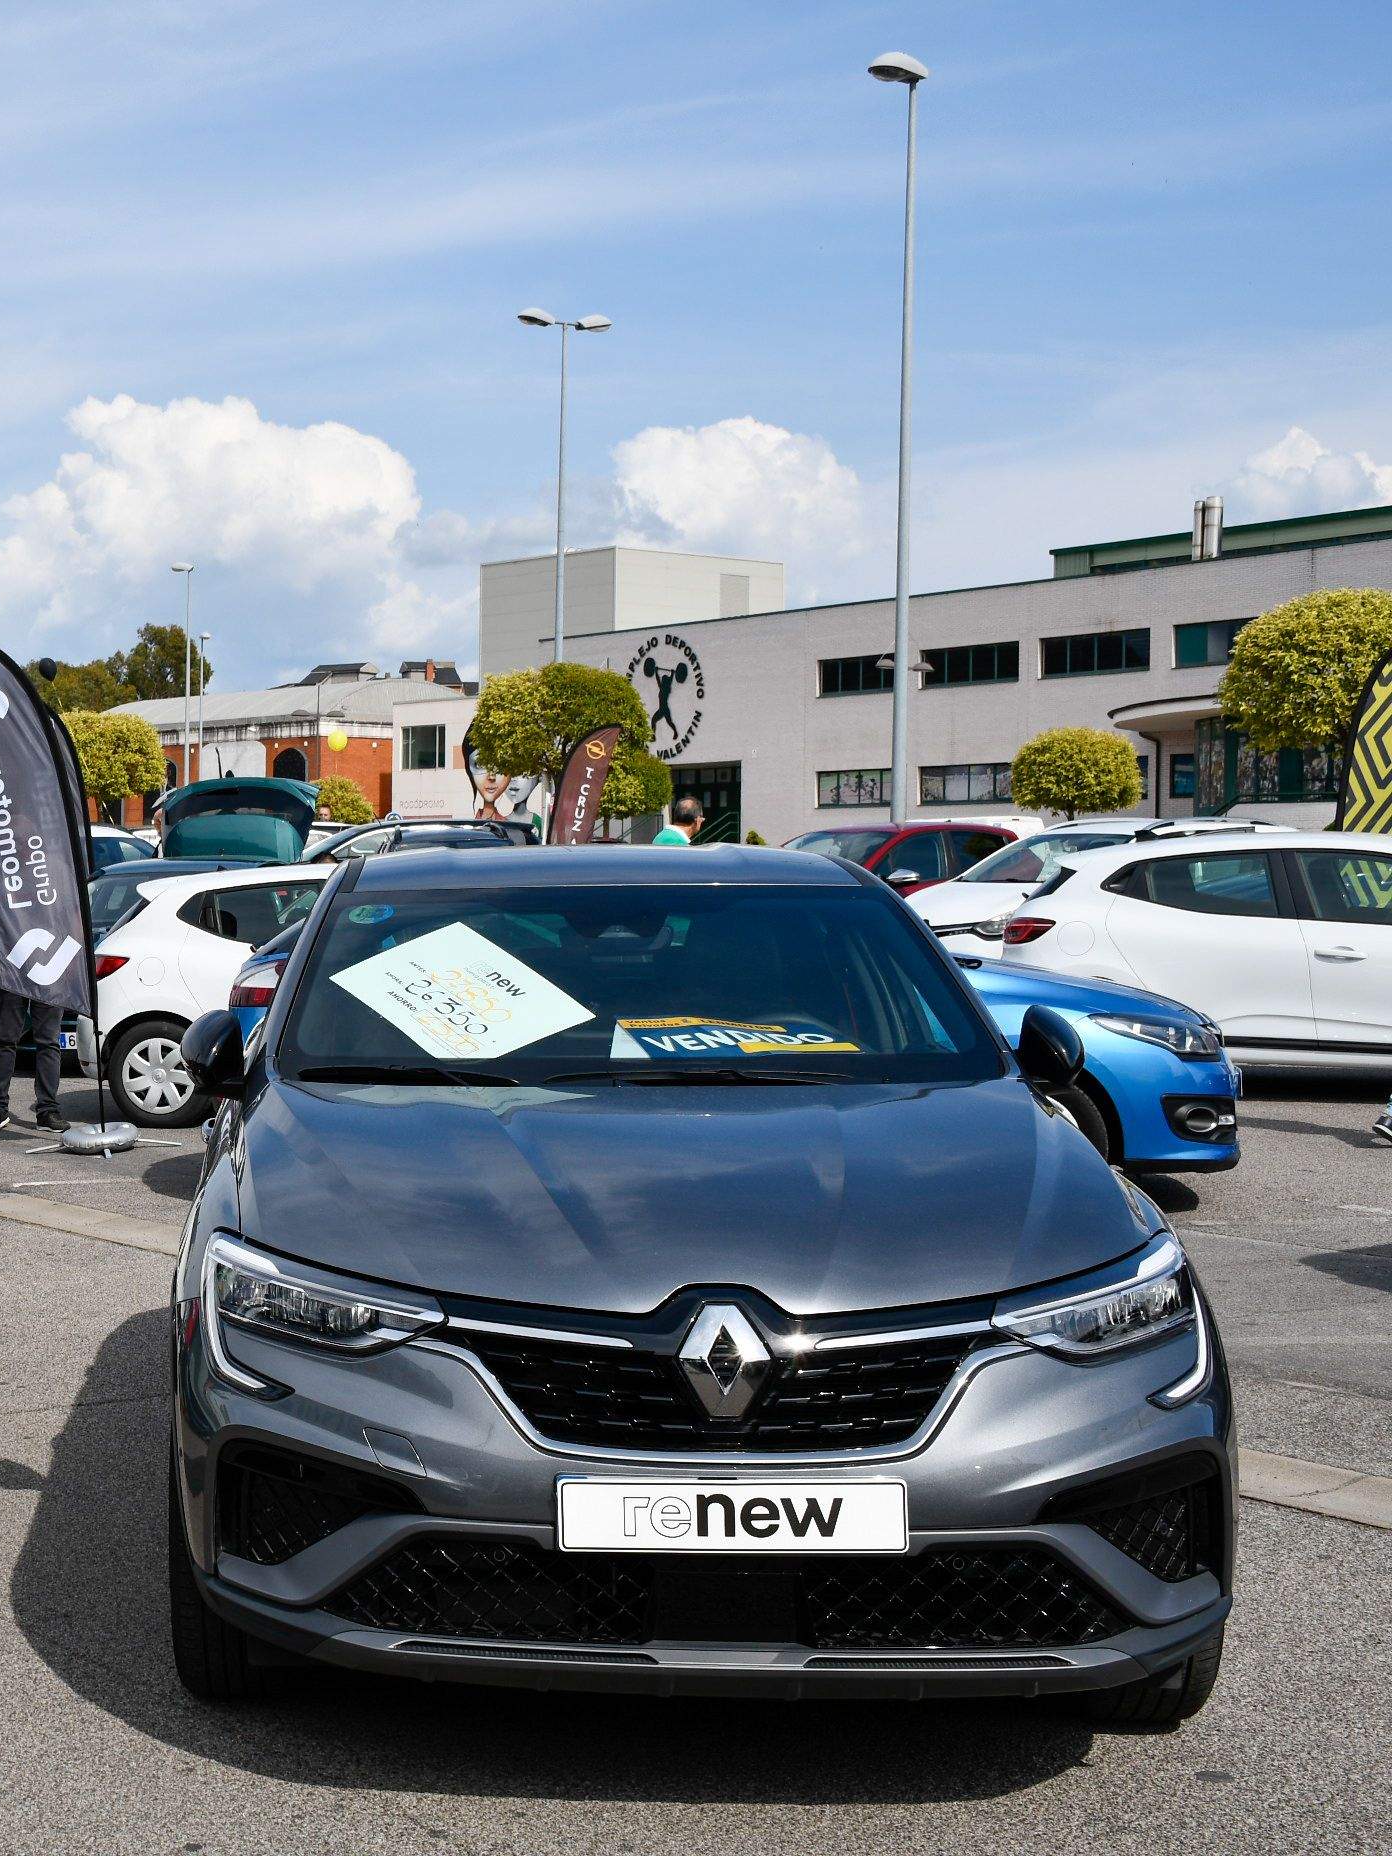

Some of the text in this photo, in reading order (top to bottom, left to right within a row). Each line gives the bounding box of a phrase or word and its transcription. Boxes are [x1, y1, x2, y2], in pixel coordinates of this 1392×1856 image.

[665, 634, 705, 699] DEPORTIVO
[571, 784, 591, 832] CRUZ
[642, 1028, 834, 1053] VENDIDO
[622, 1493, 844, 1539] renew
